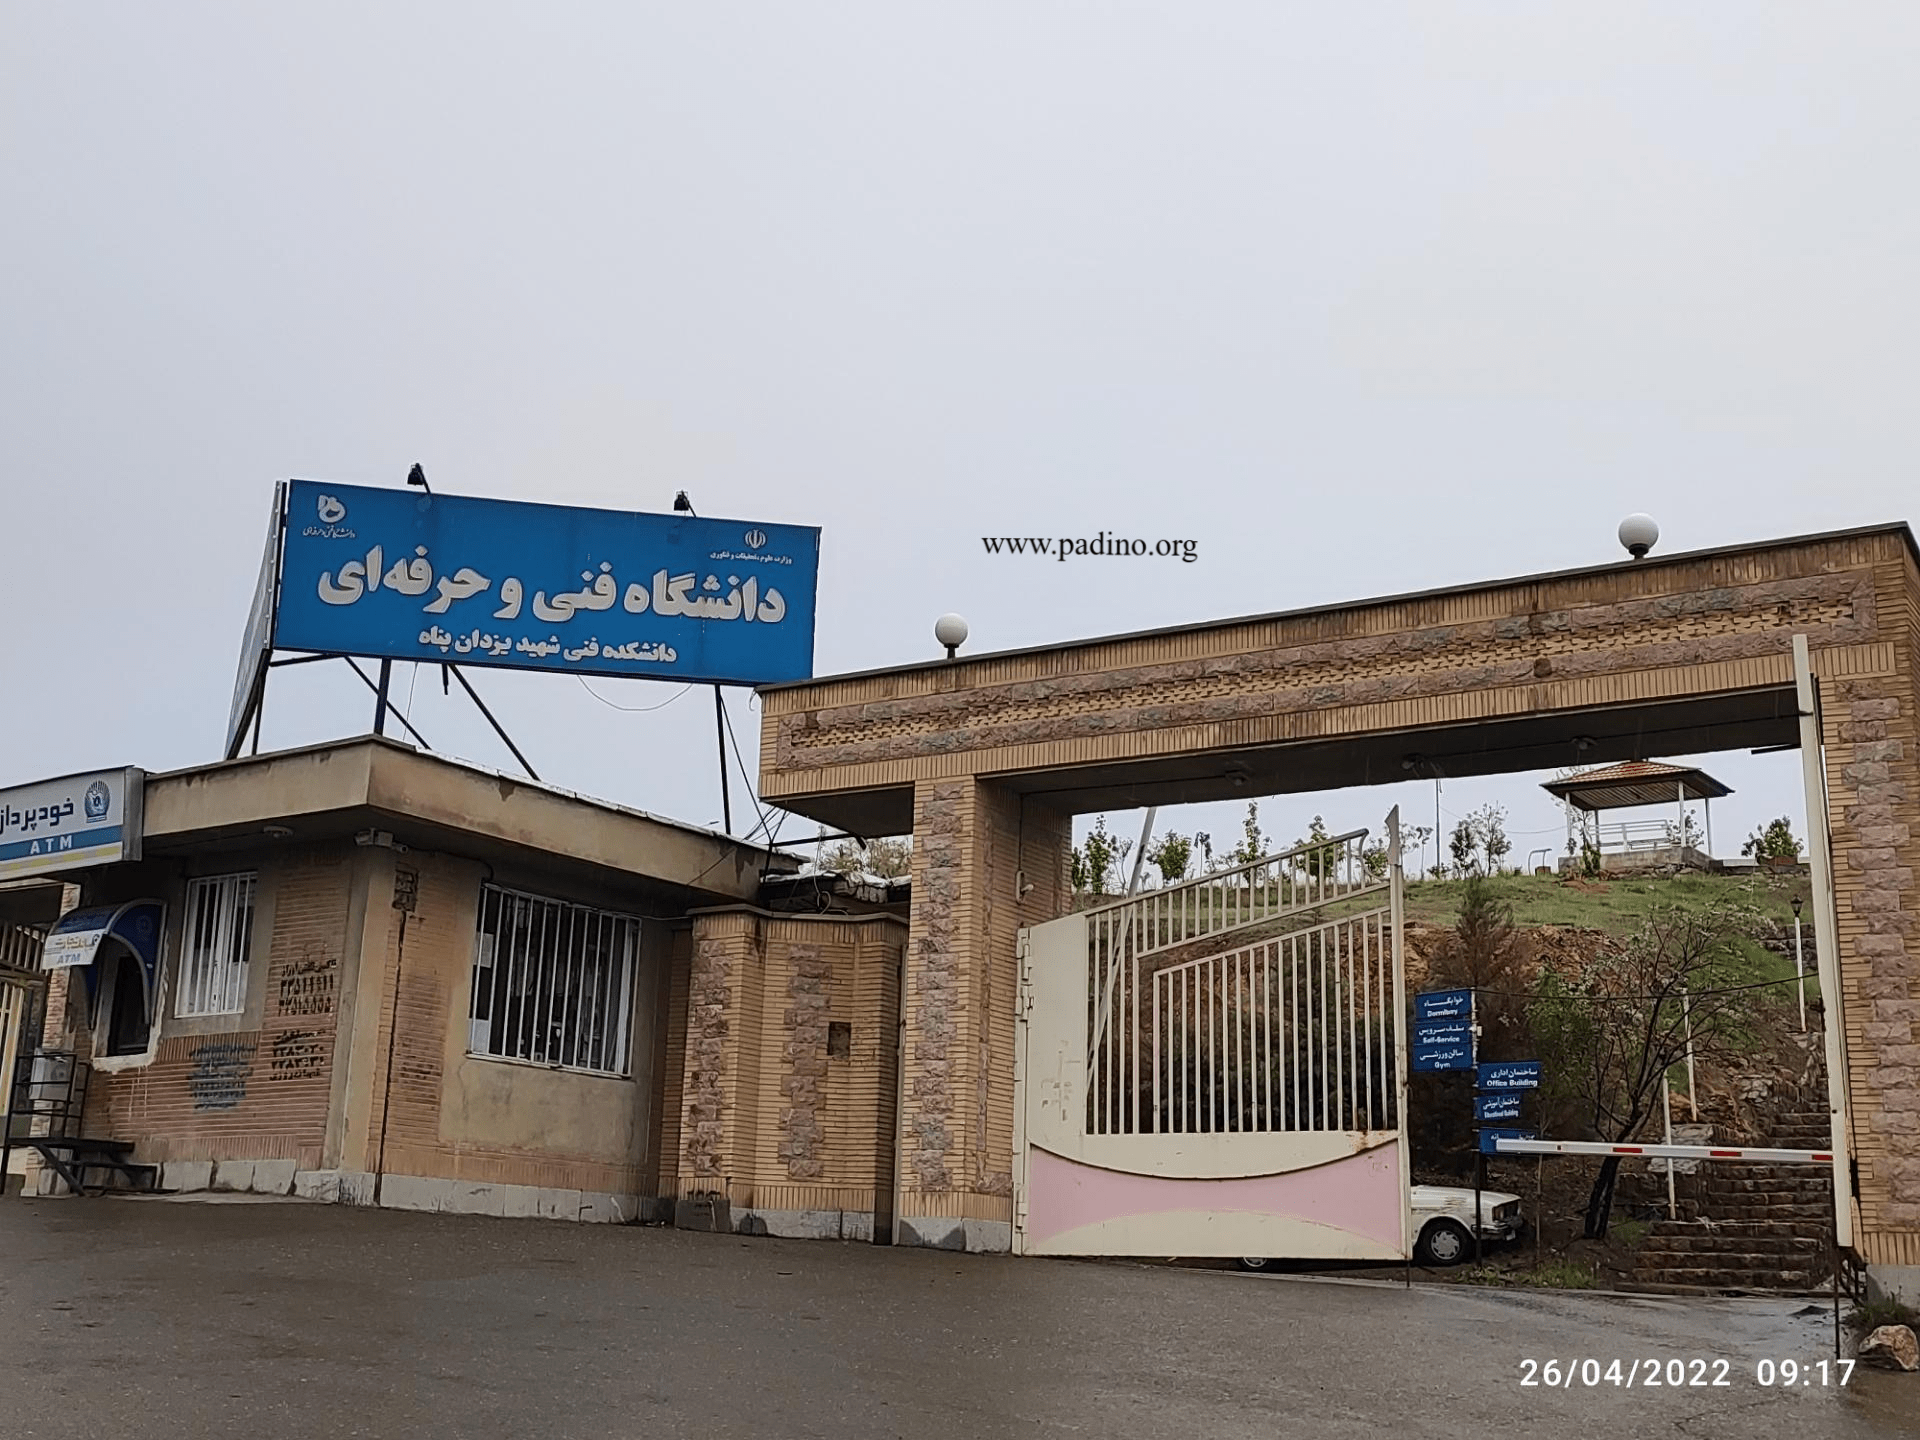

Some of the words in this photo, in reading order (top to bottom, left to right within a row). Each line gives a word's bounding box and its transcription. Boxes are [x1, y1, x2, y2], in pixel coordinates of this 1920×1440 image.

[493, 576, 524, 620] و
[532, 560, 618, 623] فنی
[623, 568, 787, 624] دانشگاه
[418, 625, 452, 653] پناه
[454, 628, 512, 656] یزدان
[515, 635, 562, 659] شهید
[563, 636, 601, 662] فنی
[602, 642, 678, 663] دانشکده
[30, 835, 73, 855] ATM
[57, 953, 81, 965] ATM
[1434, 1061, 1451, 1070] Gym
[1486, 1079, 1508, 1087] Office
[1509, 1078, 1538, 1088] Building
